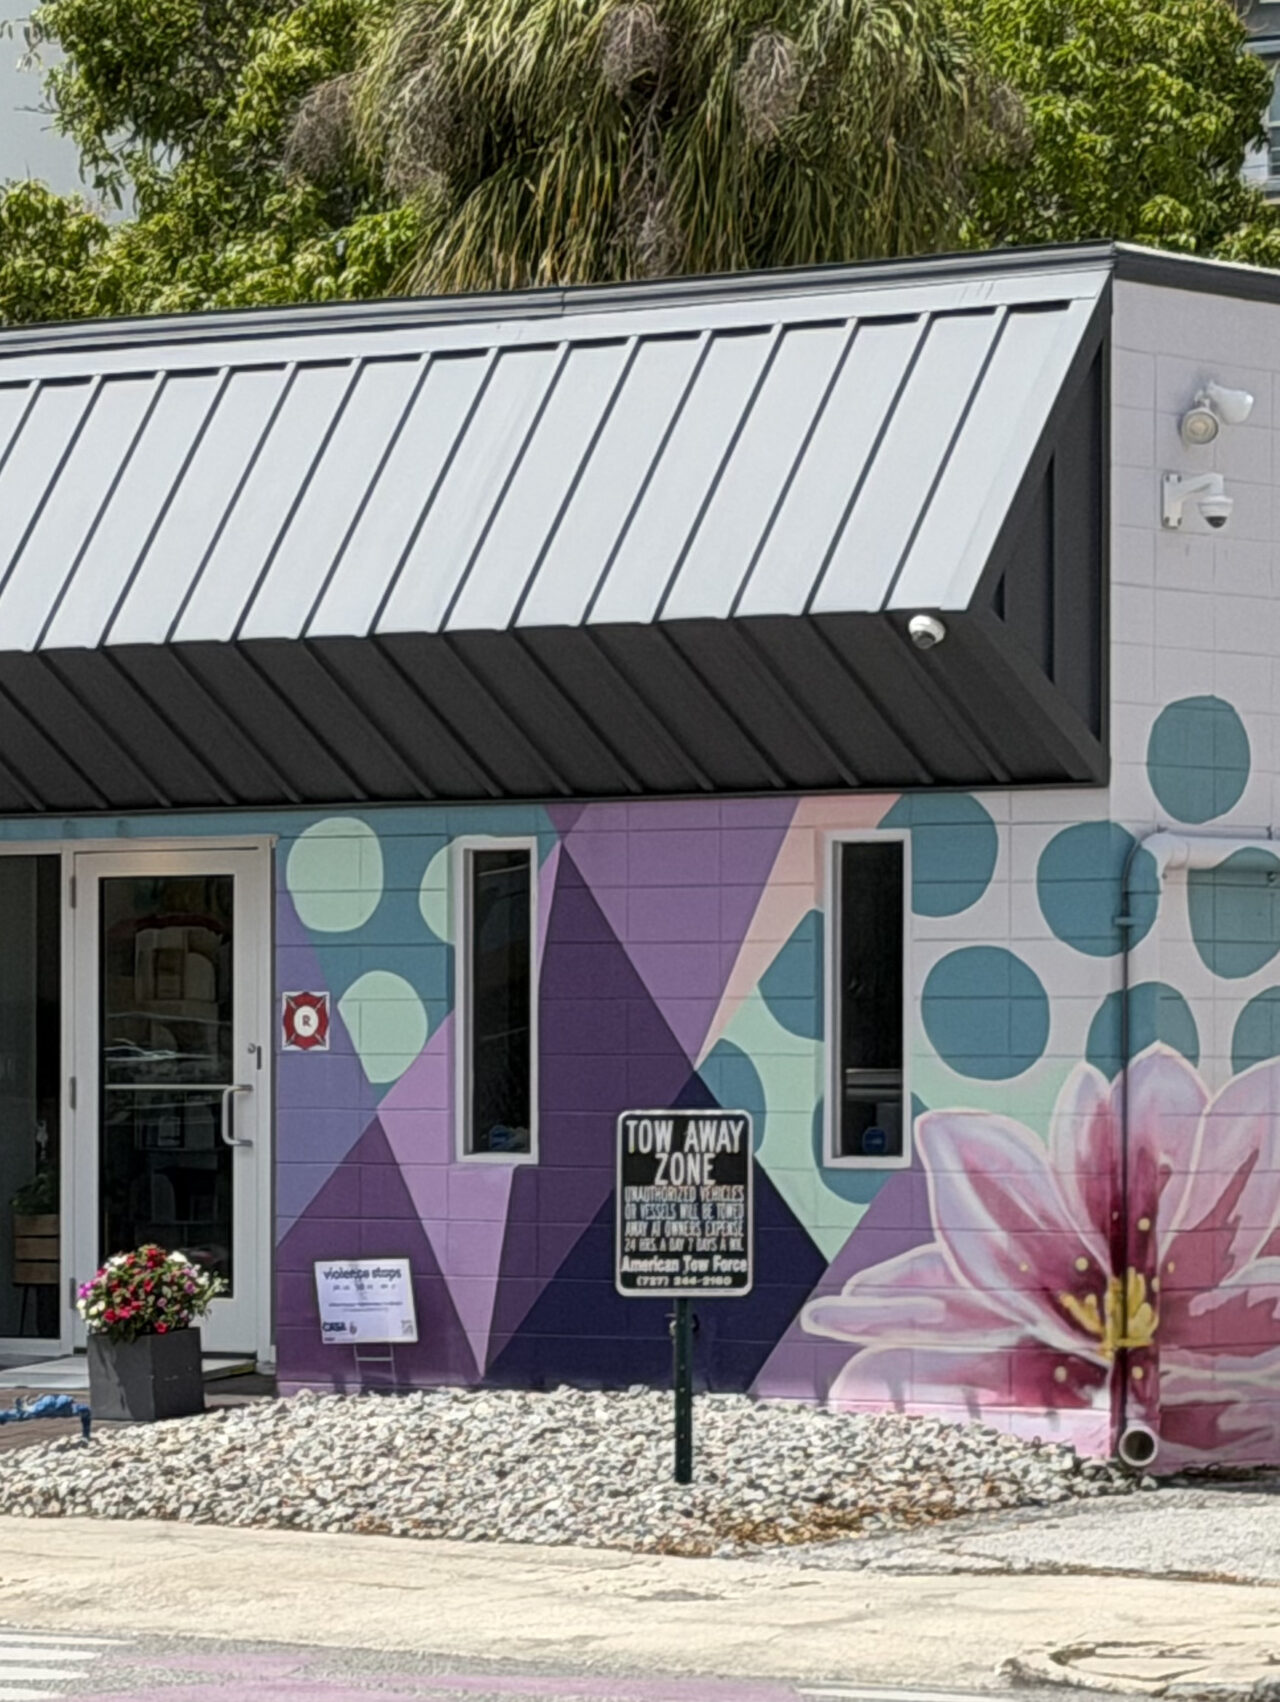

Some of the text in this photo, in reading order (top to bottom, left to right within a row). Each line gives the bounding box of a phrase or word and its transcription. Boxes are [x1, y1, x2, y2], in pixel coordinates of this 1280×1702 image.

[302, 1014, 312, 1027] R
[625, 1119, 745, 1153] TOW AWAY
[654, 1151, 716, 1185] ZONE
[624, 1184, 744, 1202] UNAUTHORIZED VEHICLES
[624, 1203, 744, 1220] OR VESSELS WILL BE TOWED
[624, 1220, 648, 1237] AWAY
[650, 1220, 661, 1237] AT
[704, 1220, 744, 1237] EXPENSE
[624, 1237, 636, 1251] 24
[659, 1237, 667, 1251] A
[669, 1237, 685, 1251] DAY
[687, 1237, 694, 1251] 7
[696, 1237, 717, 1251] DAYS
[720, 1237, 727, 1251] A
[323, 1266, 370, 1280] violence
[621, 1254, 748, 1275] American Tow Force
[636, 1275, 670, 1287] (727)
